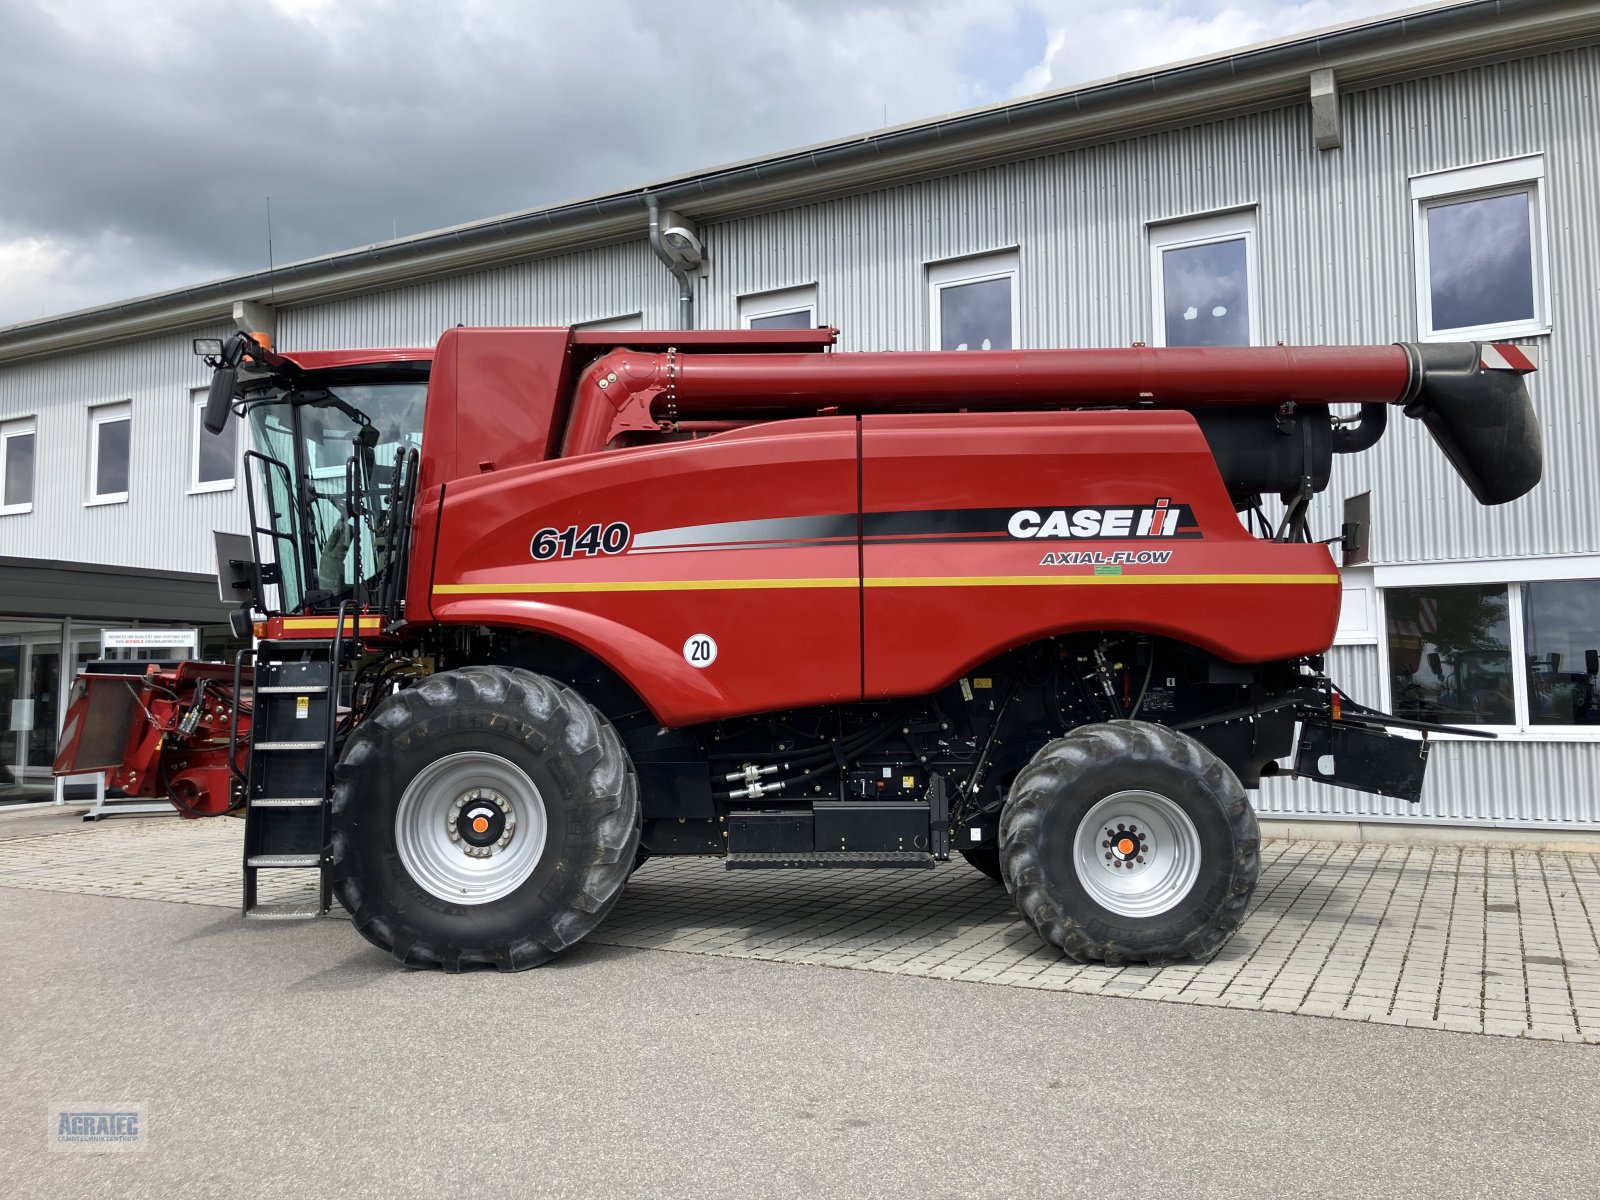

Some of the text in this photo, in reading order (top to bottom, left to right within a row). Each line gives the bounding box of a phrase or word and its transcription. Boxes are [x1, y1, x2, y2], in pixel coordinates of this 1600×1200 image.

[1007, 510, 1134, 538] CASE
[530, 521, 630, 560] 6140
[1039, 550, 1173, 565] AXIAL-FLOW
[691, 640, 710, 661] 20
